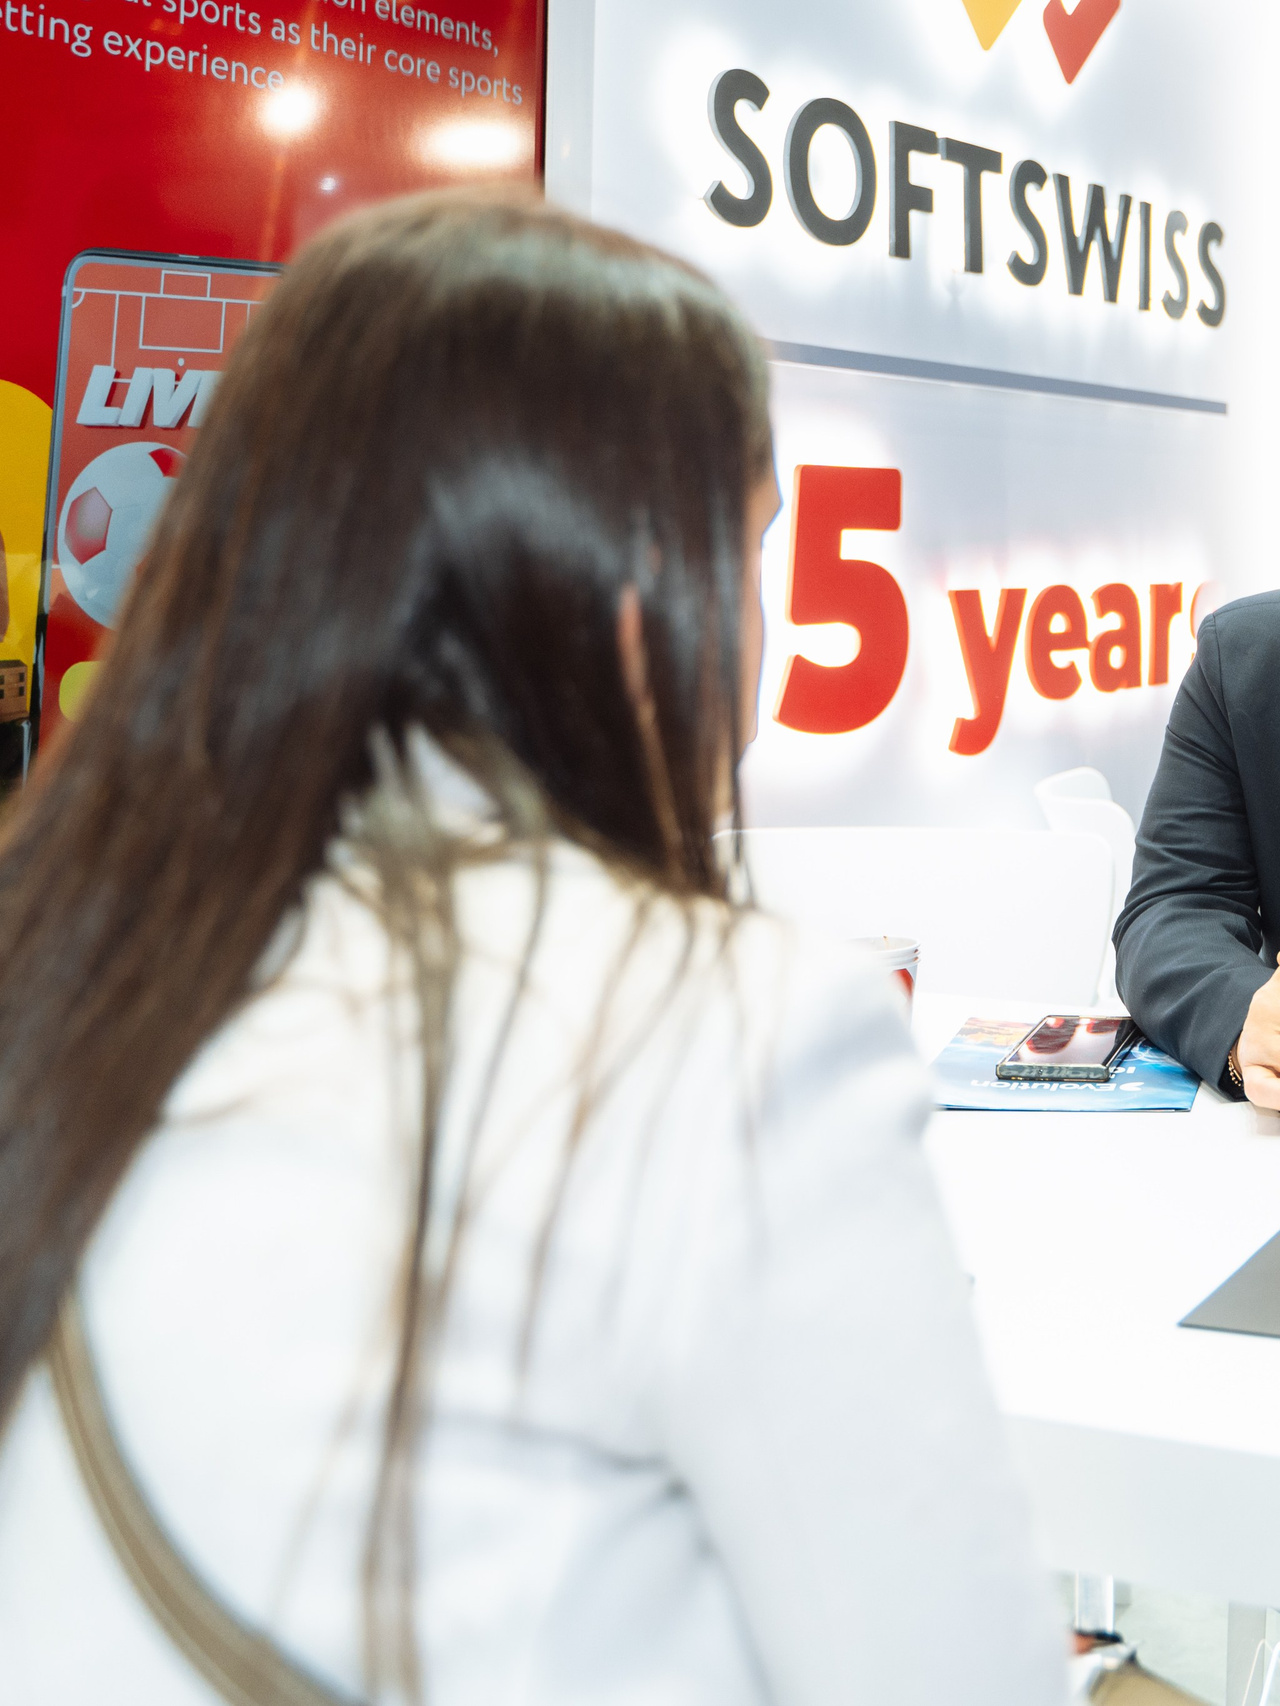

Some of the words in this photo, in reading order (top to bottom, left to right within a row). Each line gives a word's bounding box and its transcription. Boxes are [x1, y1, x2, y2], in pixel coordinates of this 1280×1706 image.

[0, 0, 94, 58] tting
[103, 30, 285, 93] experience
[271, 18, 301, 45] as
[310, 21, 377, 66] their
[384, 48, 441, 83] core
[448, 66, 523, 105] sports
[375, 0, 499, 57] elements,
[702, 68, 1227, 328] SOFTSWISS
[970, 1079, 1117, 1092] Evolution
